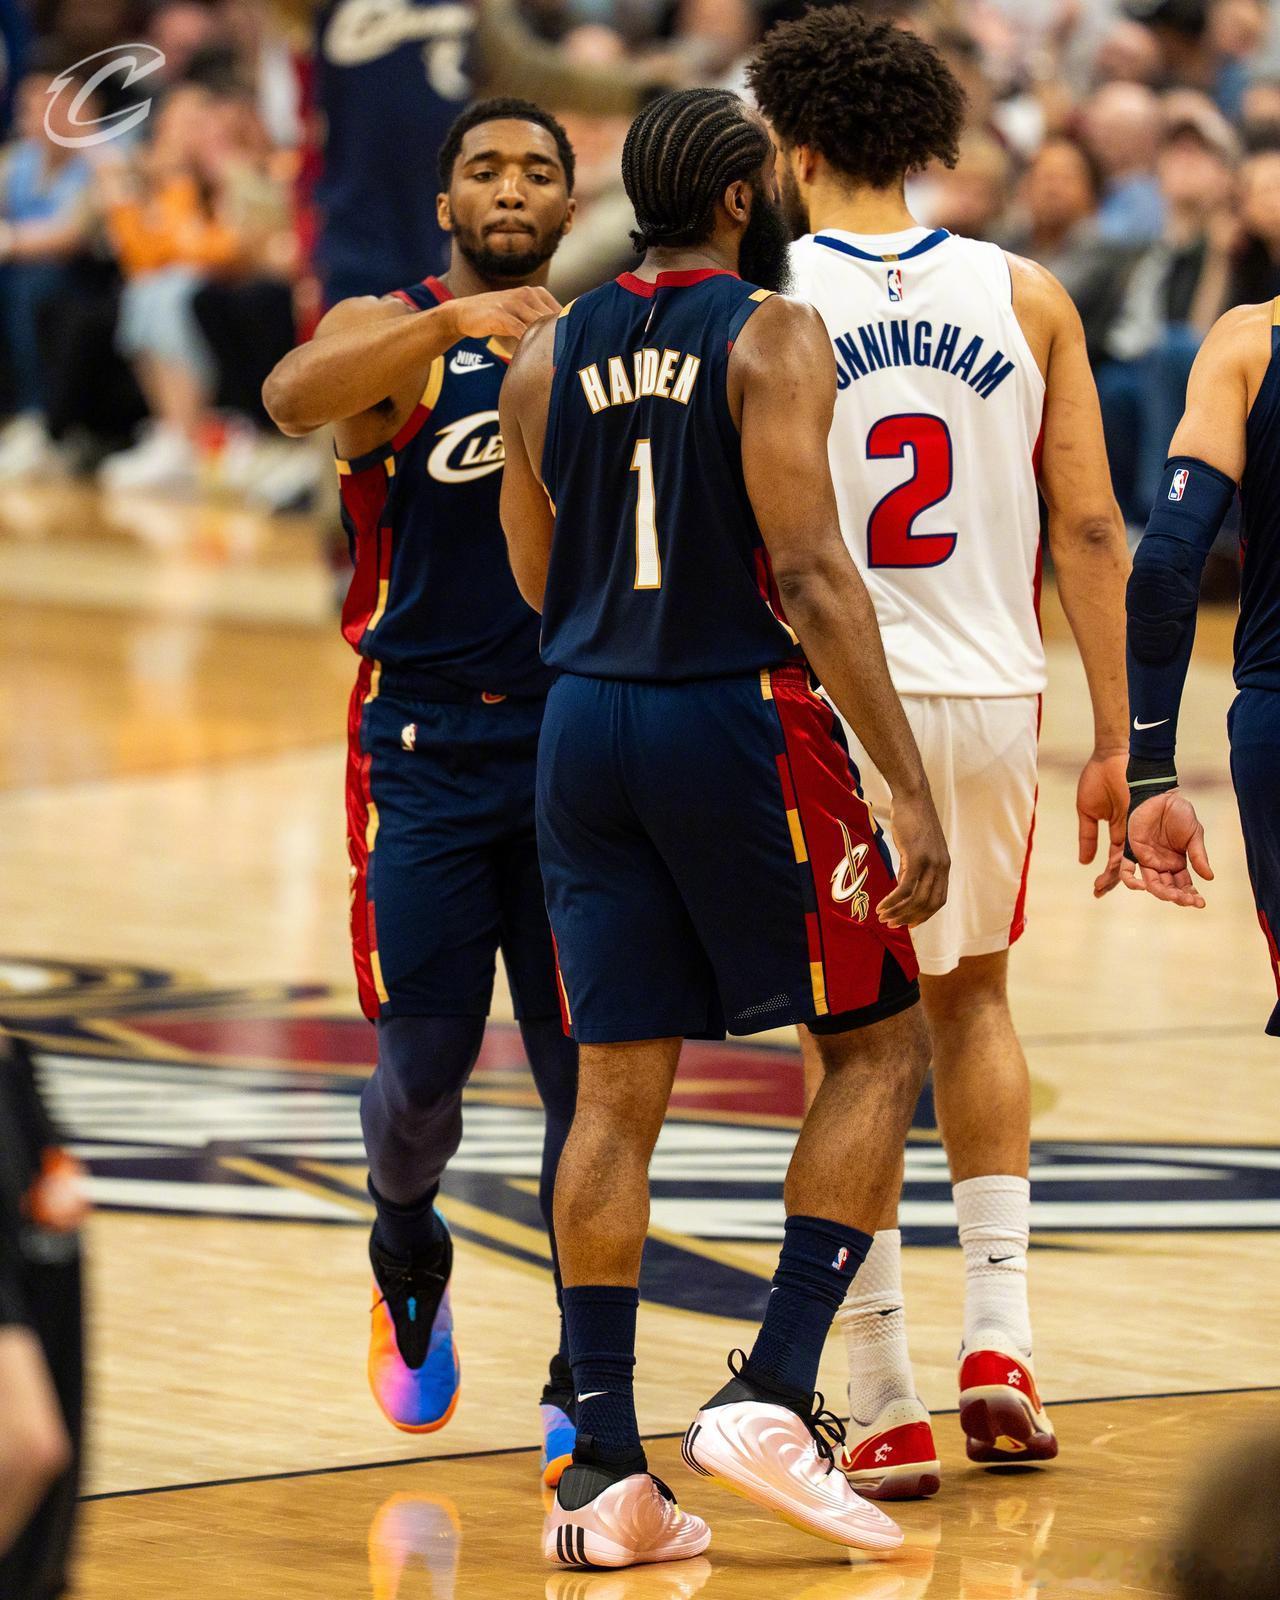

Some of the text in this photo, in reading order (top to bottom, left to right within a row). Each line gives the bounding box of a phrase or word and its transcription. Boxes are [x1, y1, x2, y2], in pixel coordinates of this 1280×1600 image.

[456, 350, 484, 366] NIKE
[629, 438, 662, 590] 1
[866, 413, 958, 569] 2
